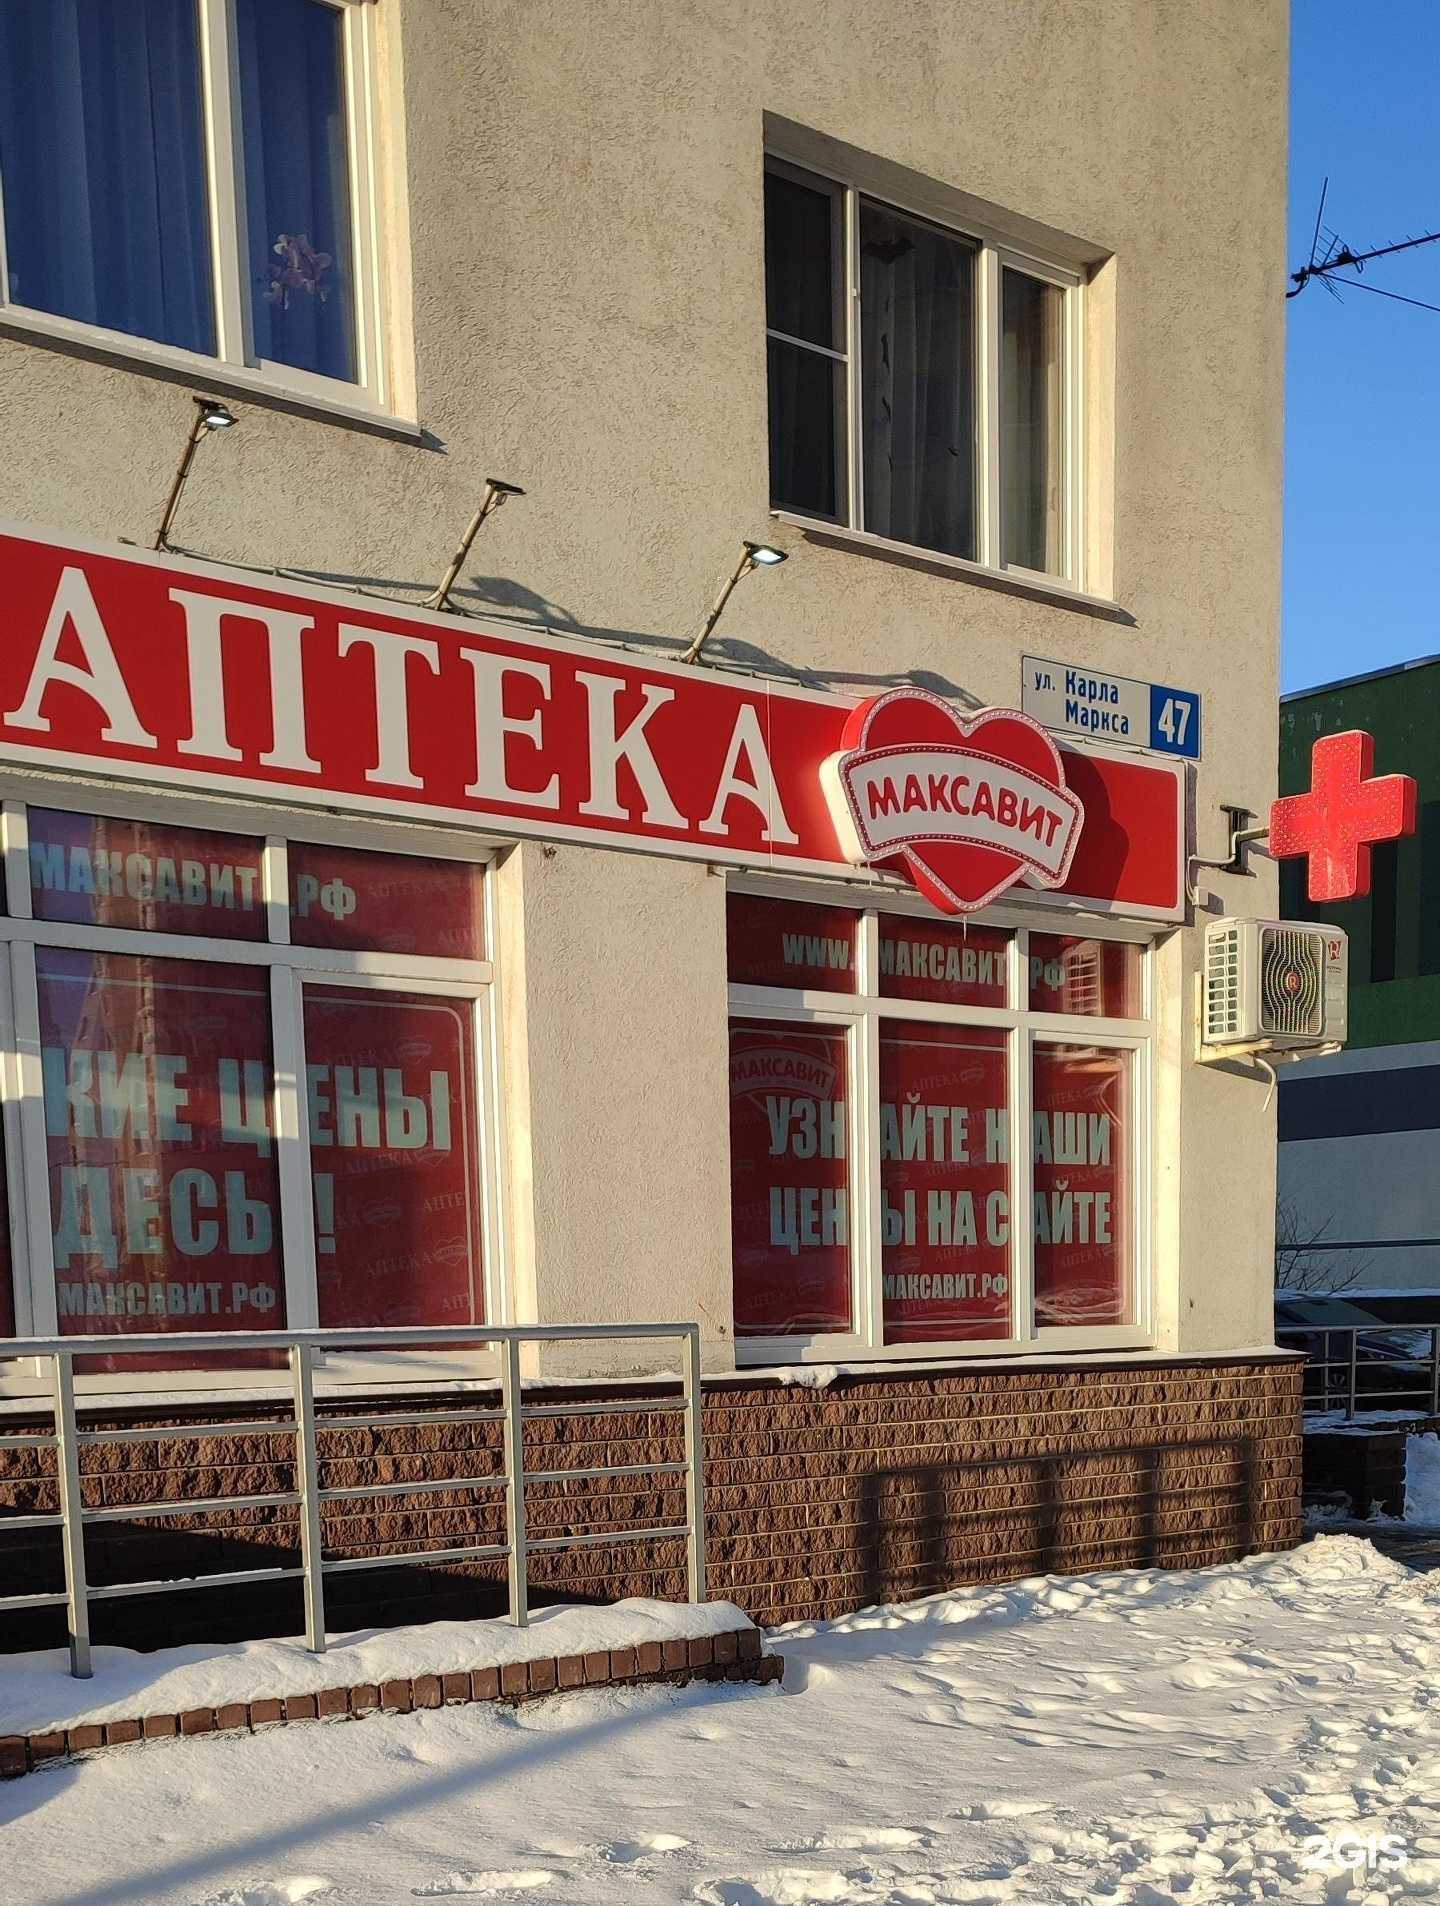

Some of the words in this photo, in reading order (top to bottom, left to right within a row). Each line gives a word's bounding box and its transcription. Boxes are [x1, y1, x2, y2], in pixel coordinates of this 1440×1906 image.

[3, 566, 799, 845] АПТЕКА
[1034, 671, 1056, 691] ул.
[1065, 669, 1119, 704] Карла
[1065, 698, 1129, 735] Маркса
[1157, 698, 1192, 746] 47
[866, 773, 1064, 848] МАКСАВИТ
[732, 1057, 831, 1088] МАКСАВИТ
[218, 1057, 451, 1158] ЦЕНЫ
[766, 1092, 970, 1163] УЗНАЙТЕ
[985, 1108, 1111, 1166] НАШИ
[769, 1186, 916, 1256] ЦЕНЫ
[927, 1190, 978, 1246] НА
[986, 1179, 1112, 1247] САЙТЕ
[57, 1281, 276, 1316] МАКСАВИТ.РФ
